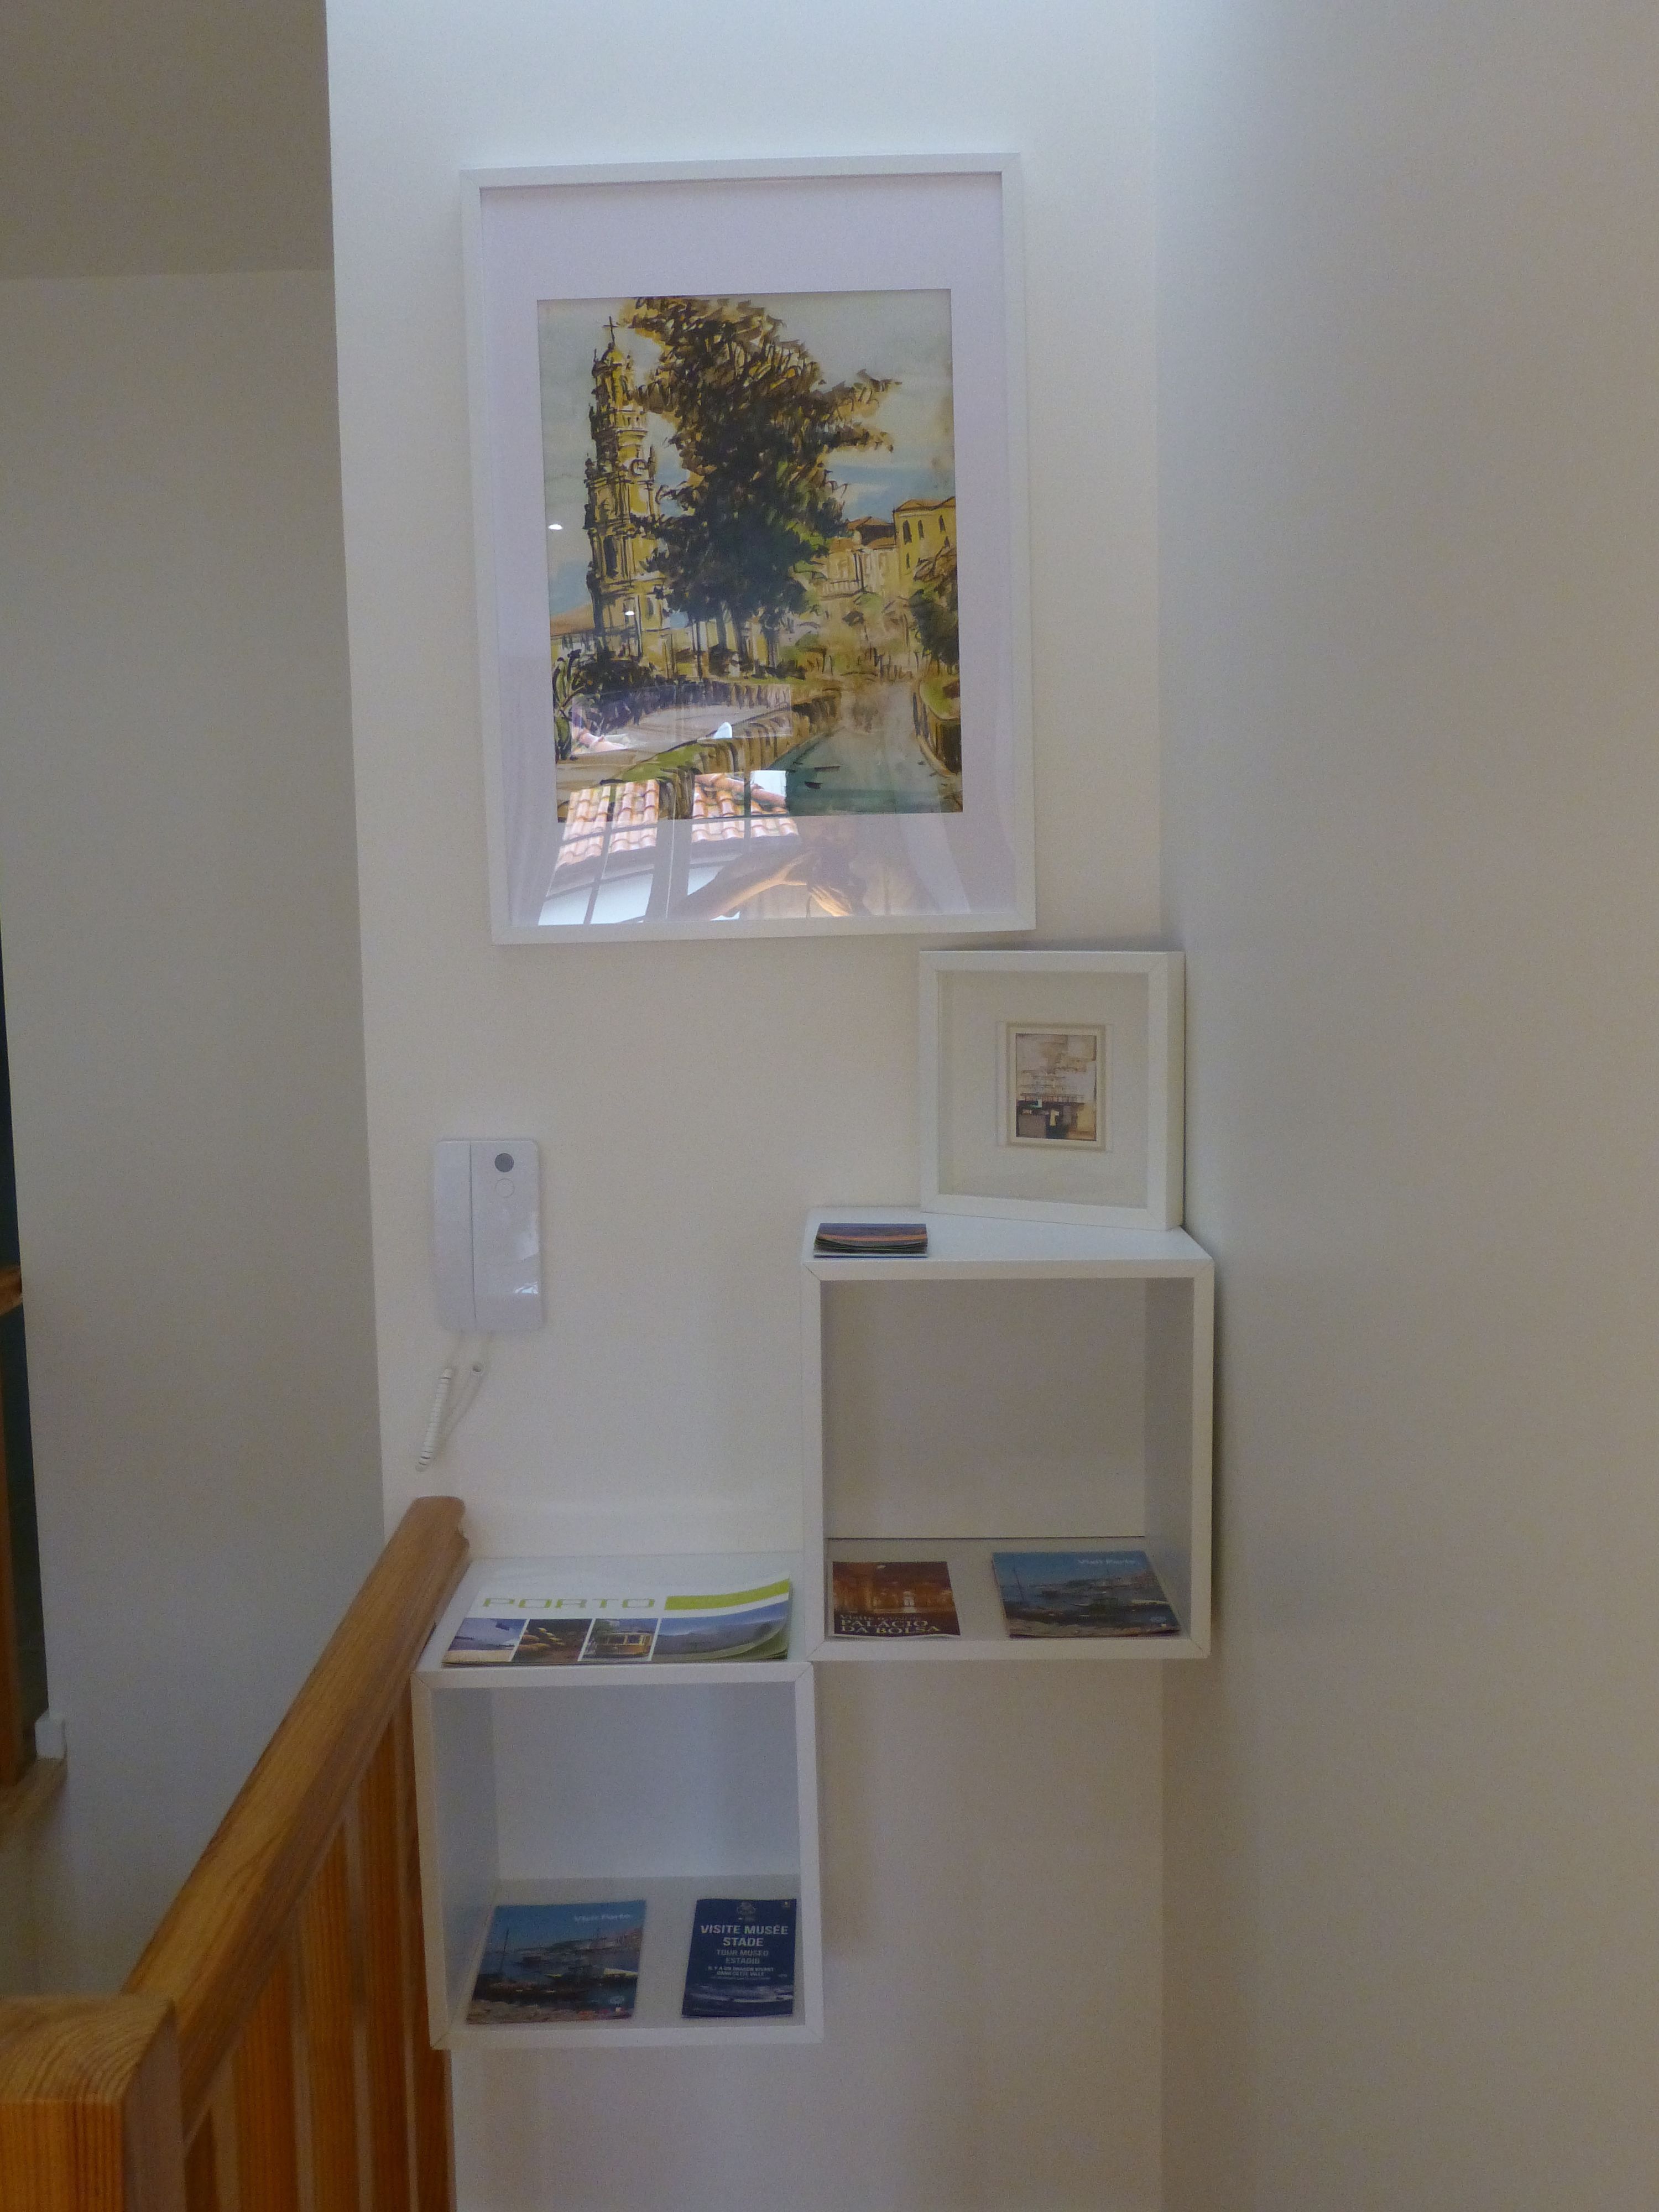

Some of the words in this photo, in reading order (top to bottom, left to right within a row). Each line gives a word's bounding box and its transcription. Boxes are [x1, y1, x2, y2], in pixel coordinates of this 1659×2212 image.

[482, 1598, 655, 1609] PORTO
[875, 1626, 941, 1634] BOLSA
[700, 1924, 740, 1934] VISITE
[744, 1924, 789, 1935] MUSÉE
[723, 1937, 764, 1947] STADE
